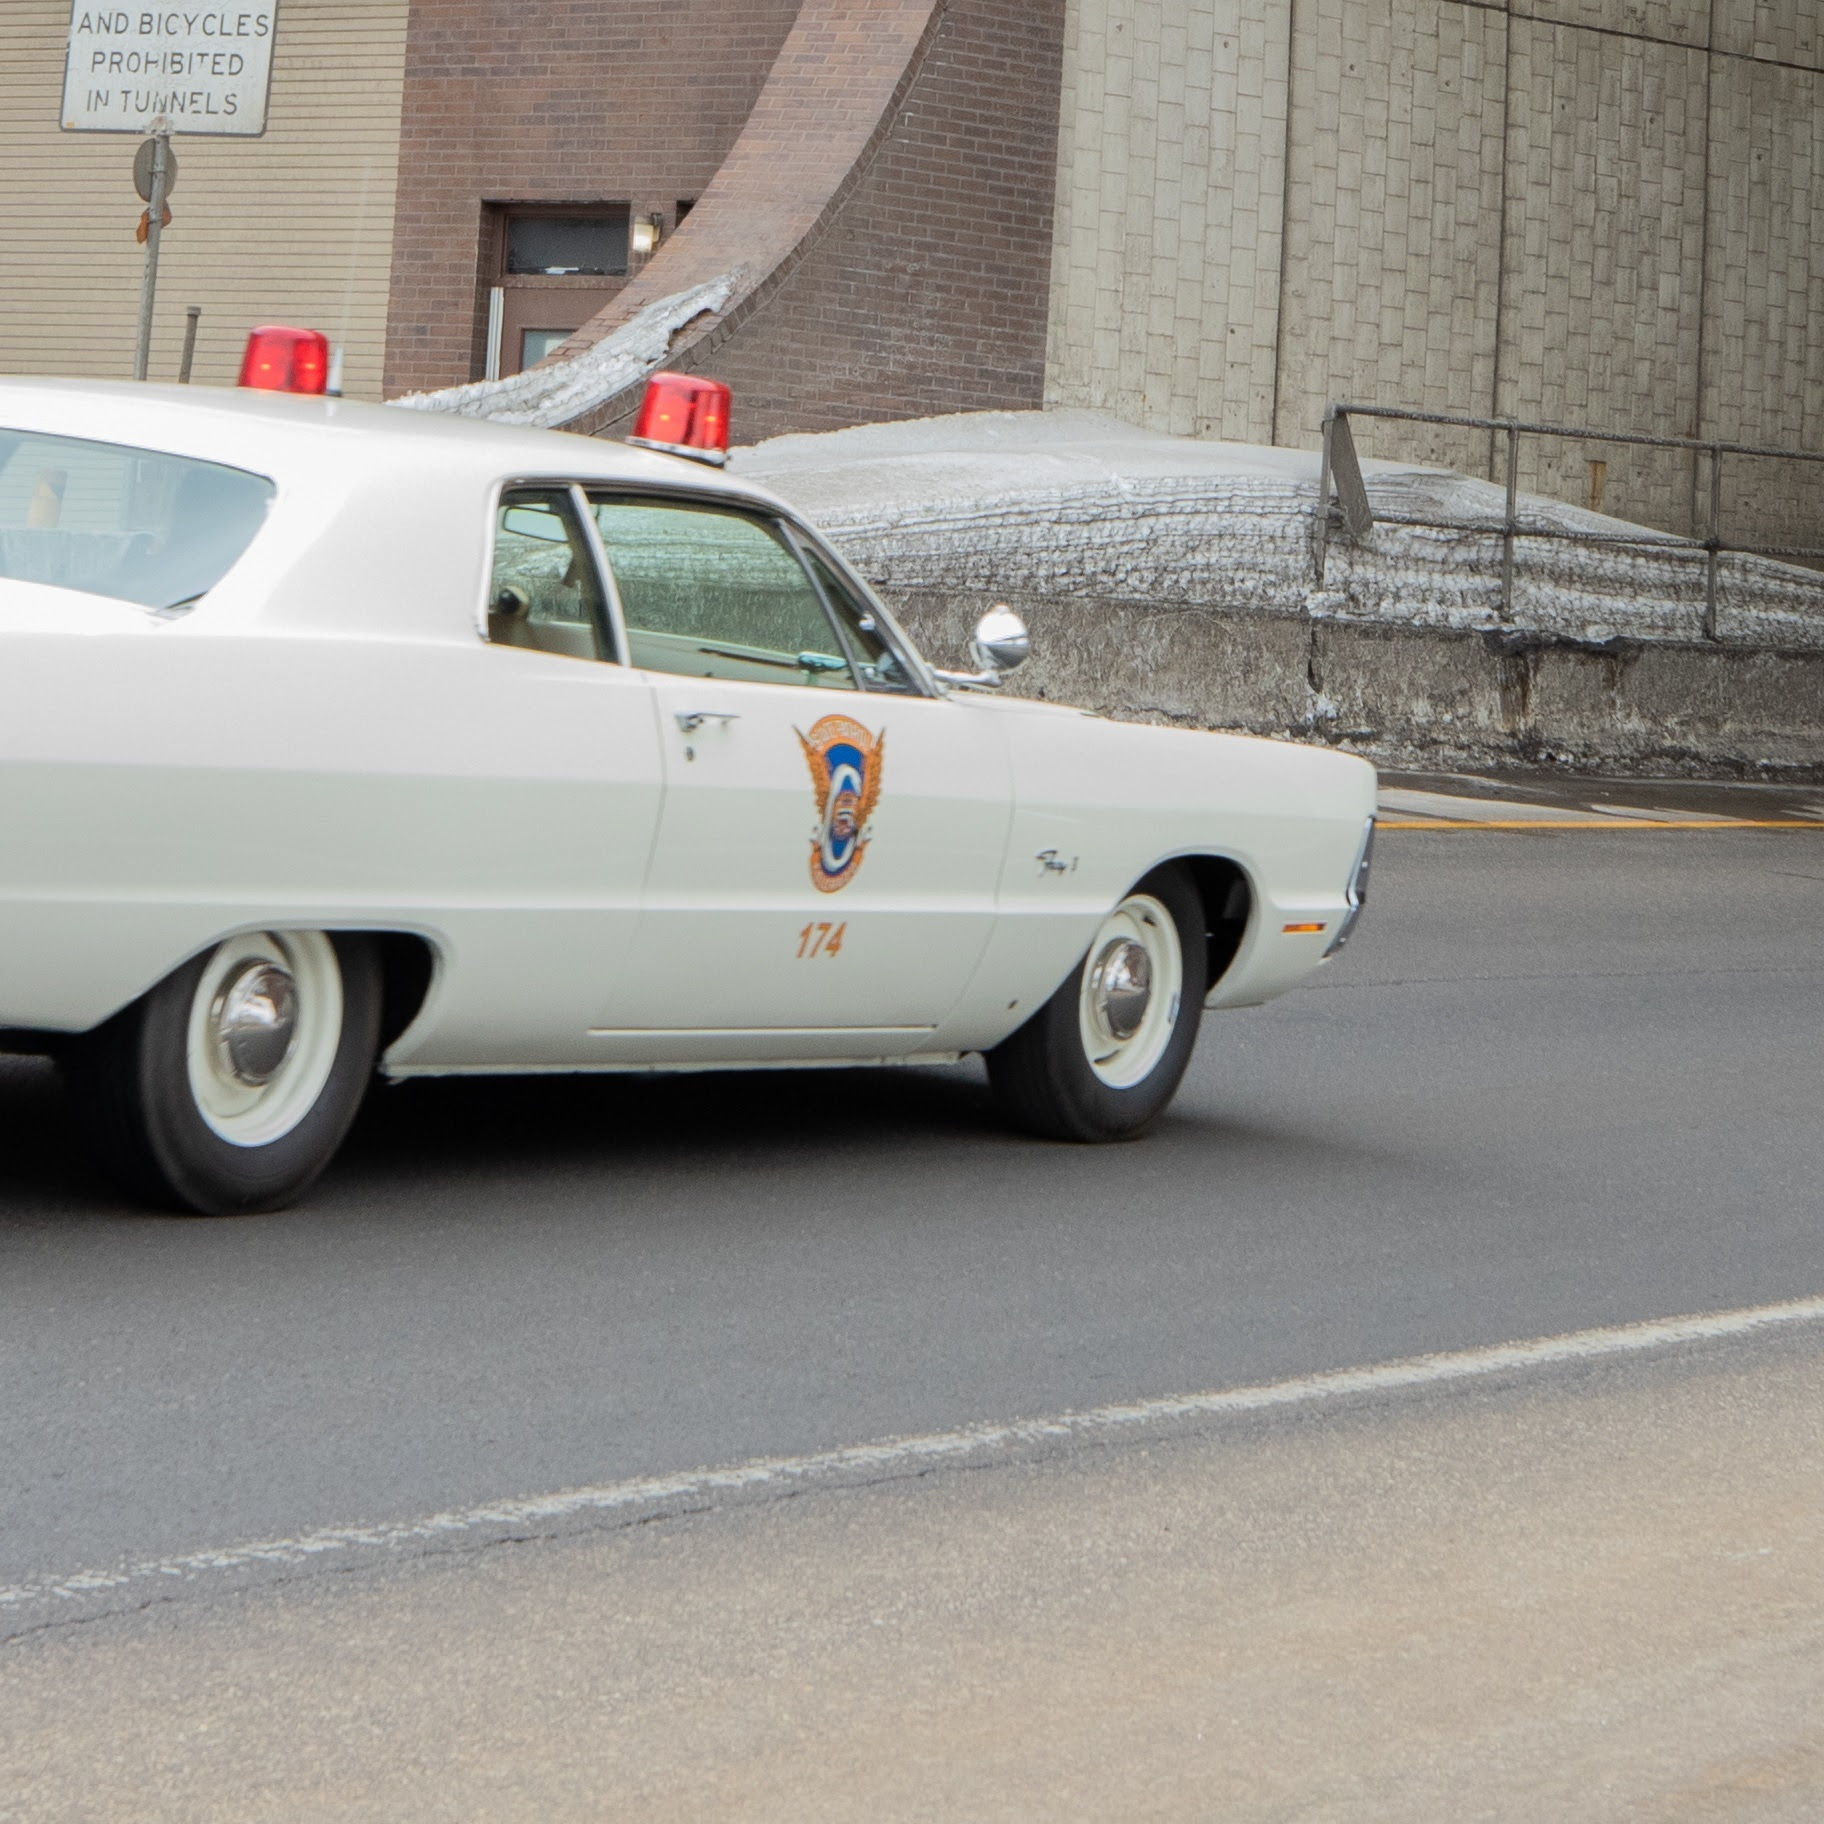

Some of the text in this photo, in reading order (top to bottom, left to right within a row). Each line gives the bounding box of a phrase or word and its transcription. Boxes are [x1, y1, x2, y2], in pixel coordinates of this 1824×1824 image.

[77, 11, 270, 37] AND BICYCLES
[91, 50, 244, 75] PROHIBITED
[86, 89, 238, 116] IN TUNNELS
[795, 921, 848, 960] 174
